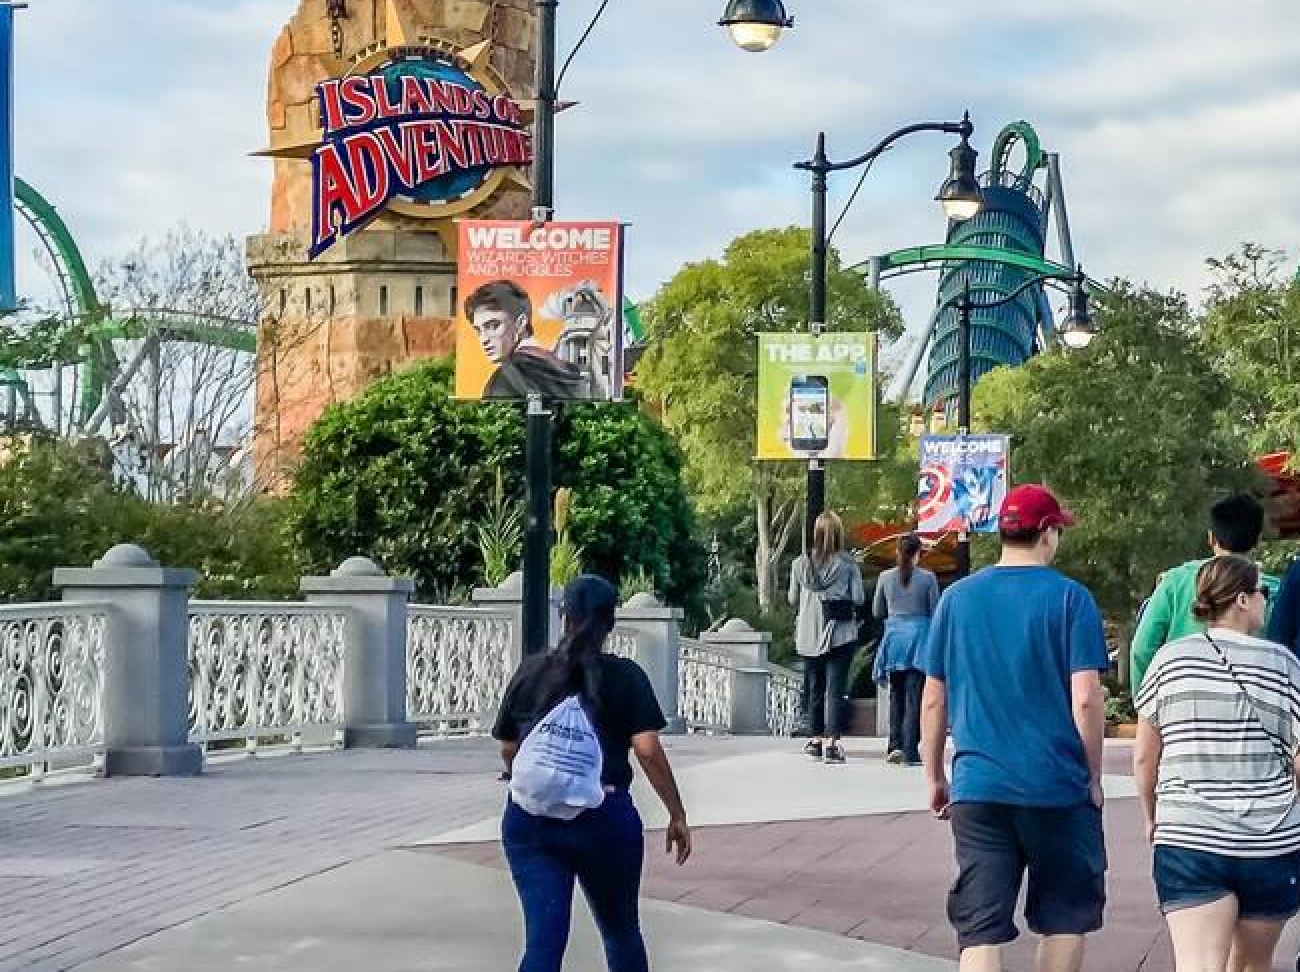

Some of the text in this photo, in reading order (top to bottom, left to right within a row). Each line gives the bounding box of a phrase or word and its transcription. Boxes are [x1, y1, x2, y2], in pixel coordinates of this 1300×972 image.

[319, 75, 491, 132] ISLANDS
[468, 227, 611, 249] WELCOME
[541, 250, 609, 264] WITCHES
[467, 263, 573, 276] AND MUGGLES
[764, 344, 866, 362] THE APP
[924, 441, 1003, 453] WELCOME
